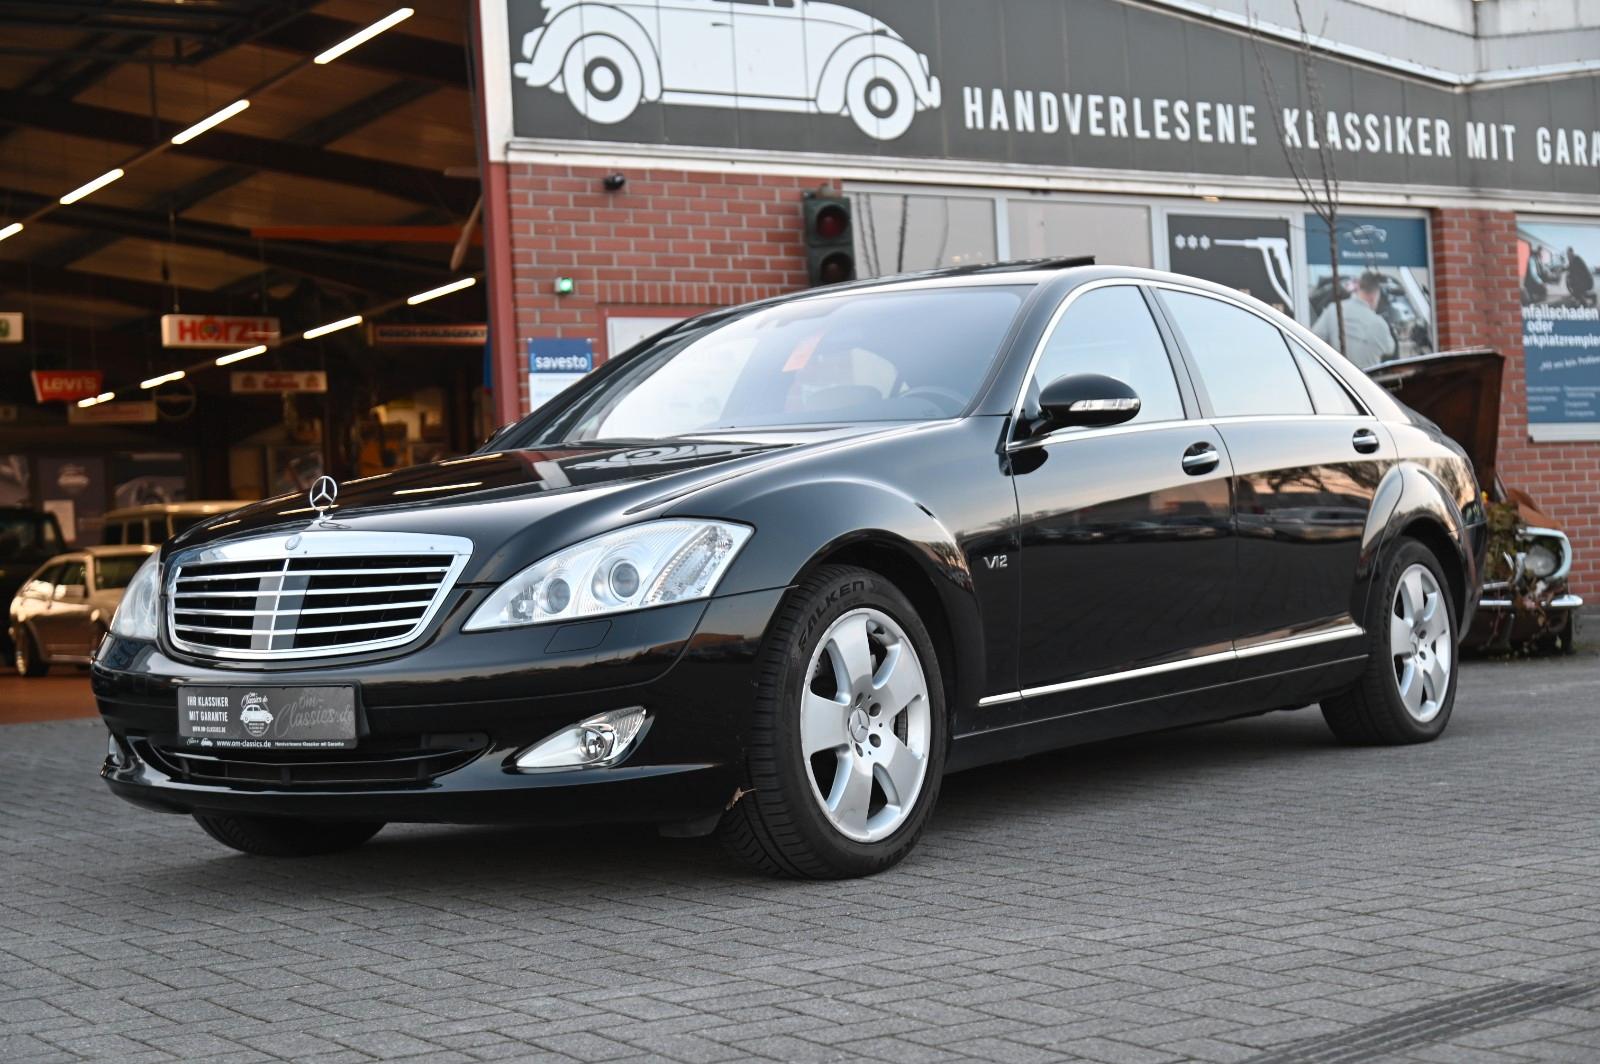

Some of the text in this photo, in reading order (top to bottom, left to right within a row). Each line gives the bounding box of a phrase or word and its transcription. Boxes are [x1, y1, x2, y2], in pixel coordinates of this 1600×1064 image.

[963, 87, 1257, 145] HANDVERLESENE
[1283, 108, 1451, 157] KLASSIKER
[1466, 121, 1515, 162] MIT
[1522, 304, 1599, 320] nfallschaden
[1527, 320, 1554, 333] oder
[1522, 333, 1600, 350] arkplatzremple
[535, 354, 588, 370] savesto
[984, 555, 1008, 569] V12
[187, 695, 229, 708] IHR KLASSIKER
[189, 711, 229, 722] MIT GARANTIE
[216, 739, 272, 748] www.om-classics.de
